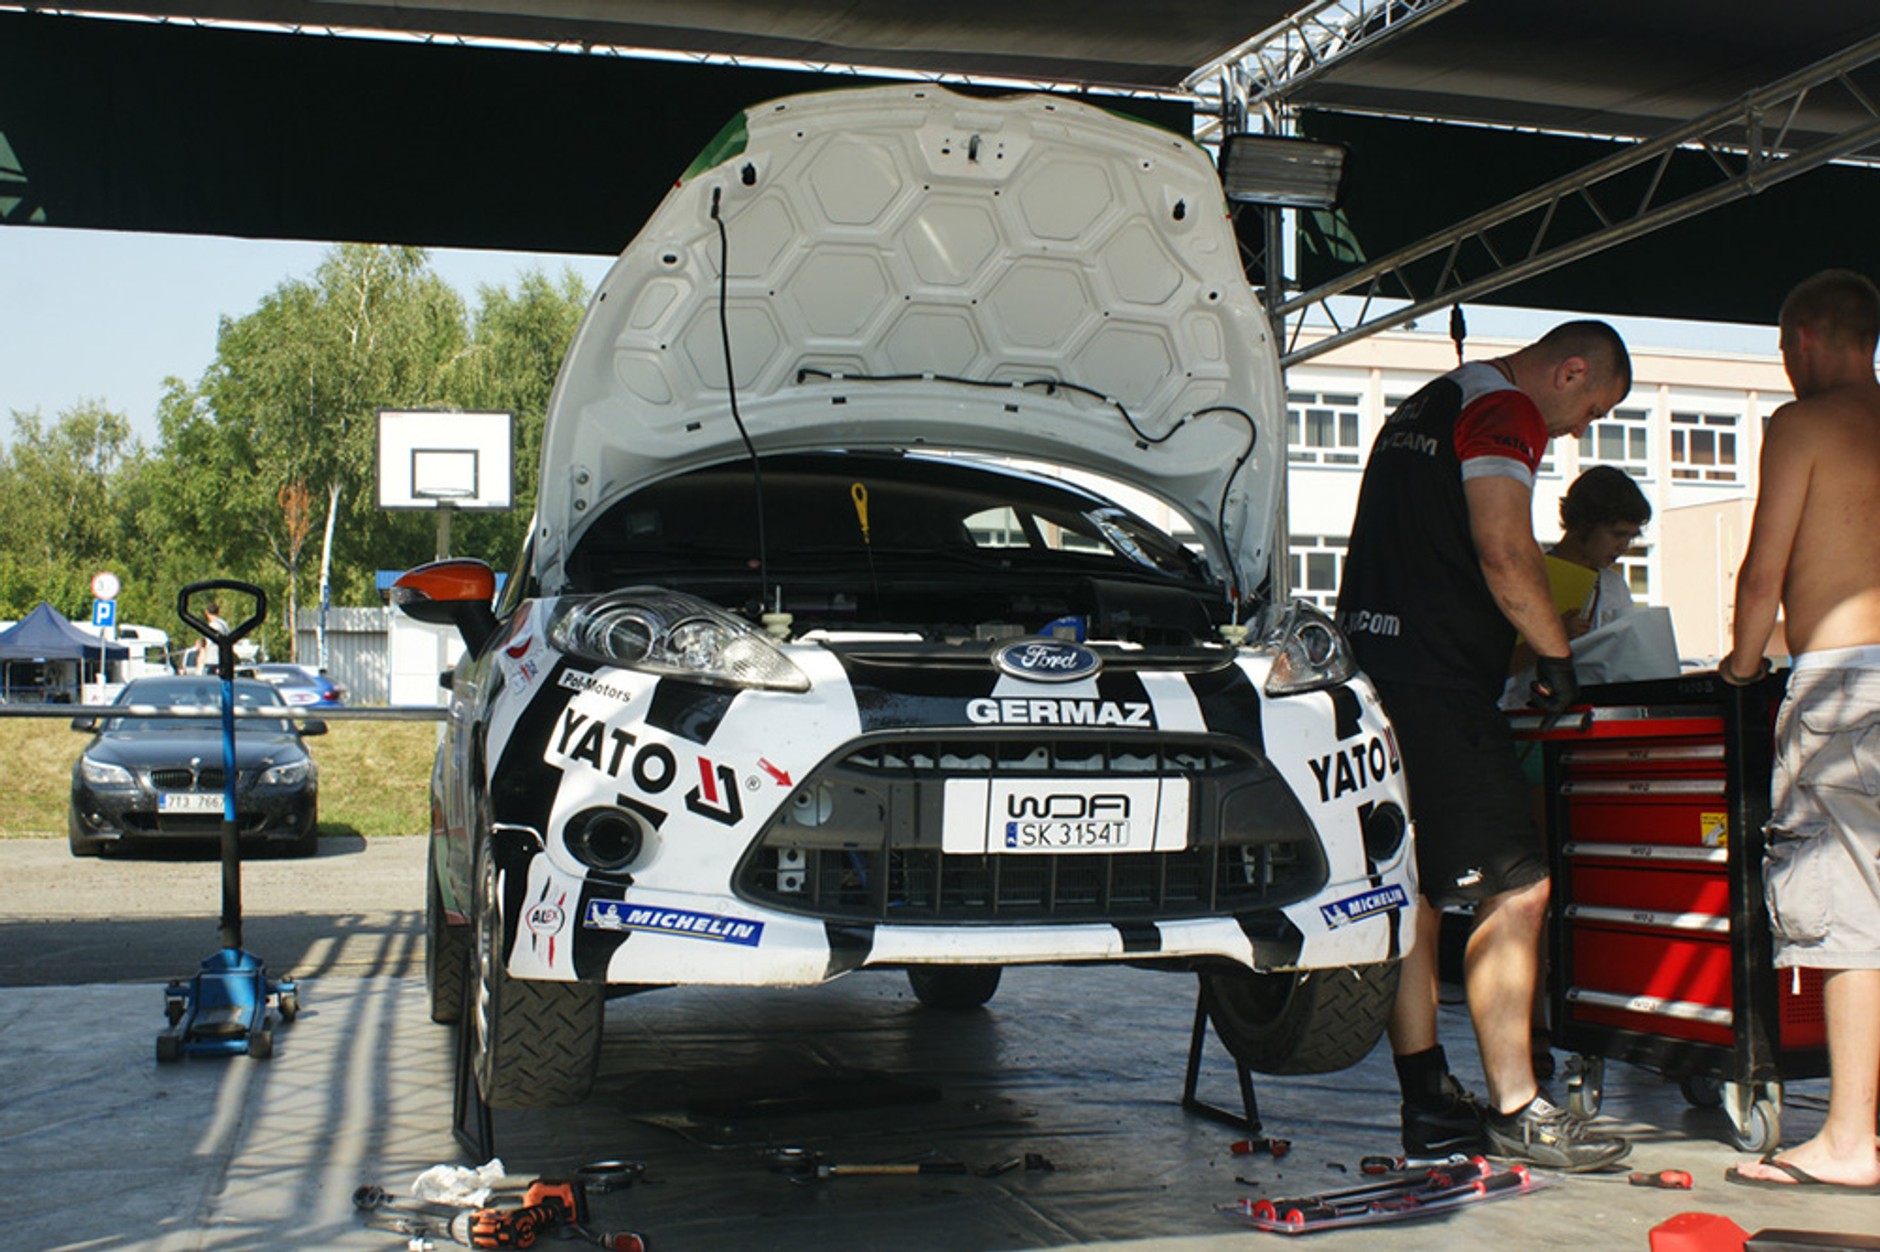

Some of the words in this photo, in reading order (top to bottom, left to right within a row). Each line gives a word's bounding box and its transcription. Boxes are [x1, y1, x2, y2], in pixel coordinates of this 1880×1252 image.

[96, 603, 111, 623] P
[1015, 644, 1078, 669] Ford
[966, 699, 1151, 727] GERMAZ
[556, 706, 677, 795] YATO
[1306, 736, 1386, 804] YATO
[1022, 823, 1052, 846] SK
[1059, 822, 1125, 845] 3154T
[1347, 887, 1404, 917] MICHELIN
[626, 909, 756, 940] MICHELIN
